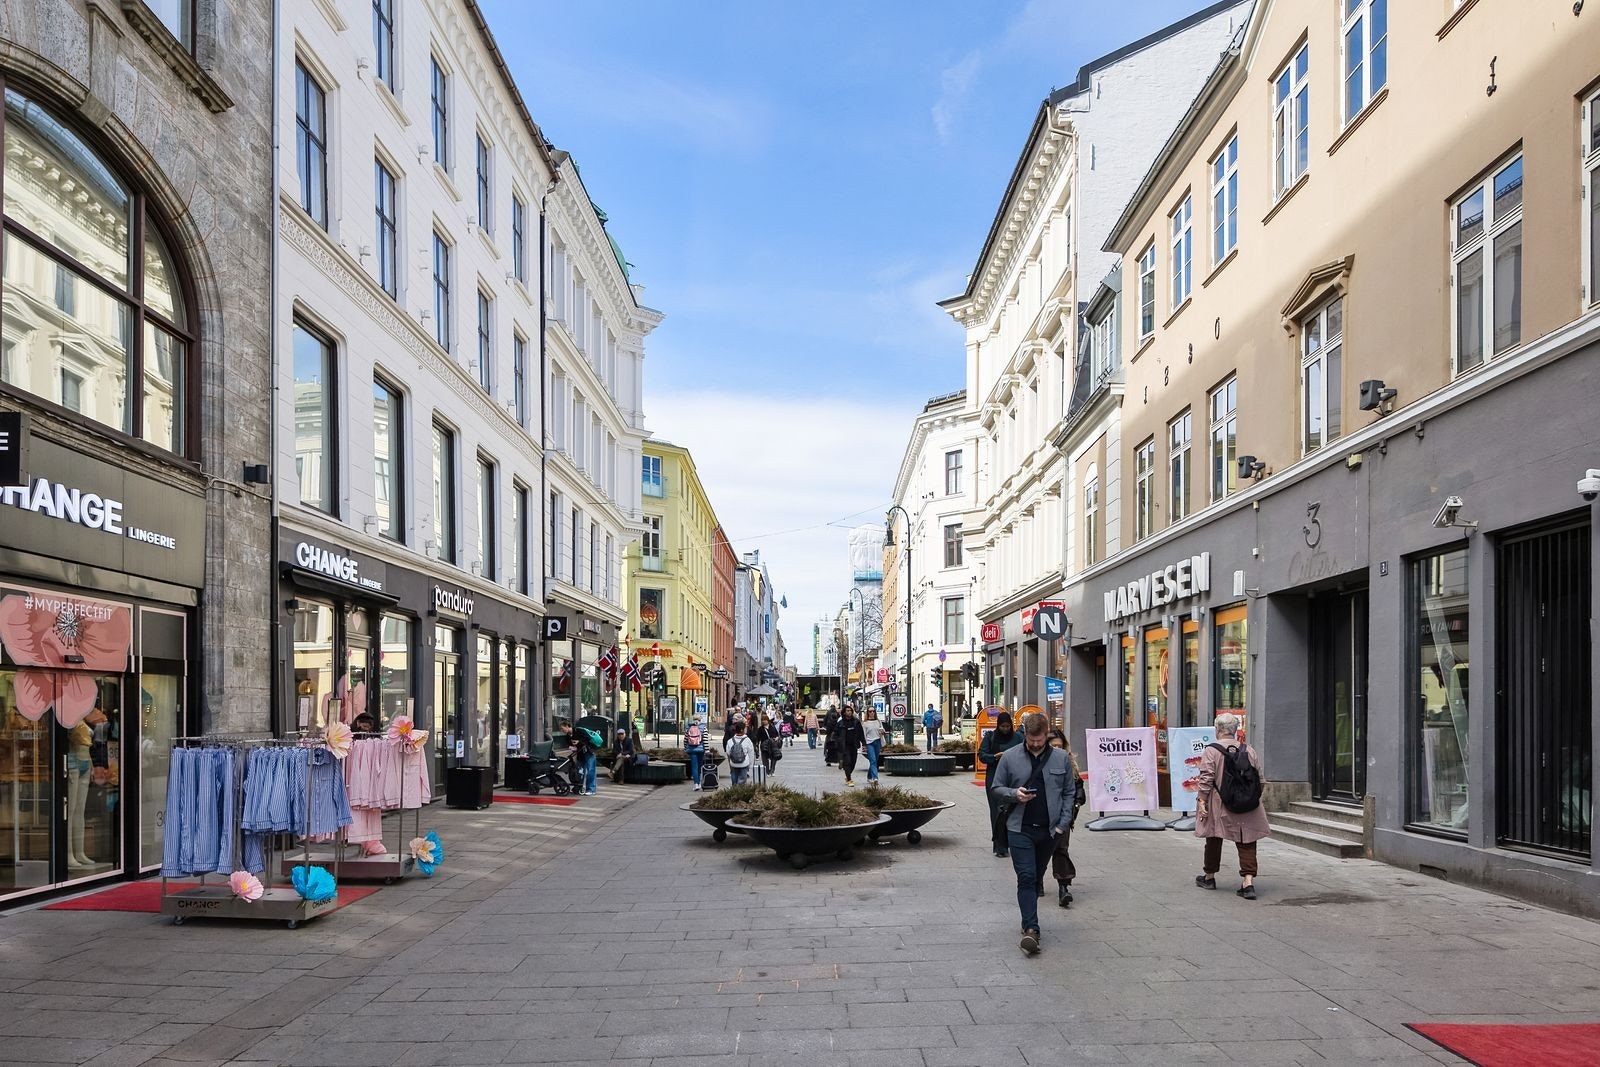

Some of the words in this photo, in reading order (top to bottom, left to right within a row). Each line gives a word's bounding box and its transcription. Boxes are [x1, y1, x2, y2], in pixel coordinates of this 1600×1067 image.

[0, 475, 123, 535] HANGE
[127, 526, 177, 550] LINGERIE
[1302, 500, 1321, 549] 3
[296, 542, 359, 583] CHANGE
[359, 577, 382, 591] LINGERIE
[1103, 551, 1211, 623] NARVESEN
[24, 596, 113, 620] #MYPERFECTFIT
[433, 584, 475, 615] panduro
[984, 625, 997, 639] deli
[1039, 612, 1061, 634] N
[895, 706, 904, 714] 30
[1098, 739, 1143, 753] softis!
[178, 900, 220, 909] CHANGE
